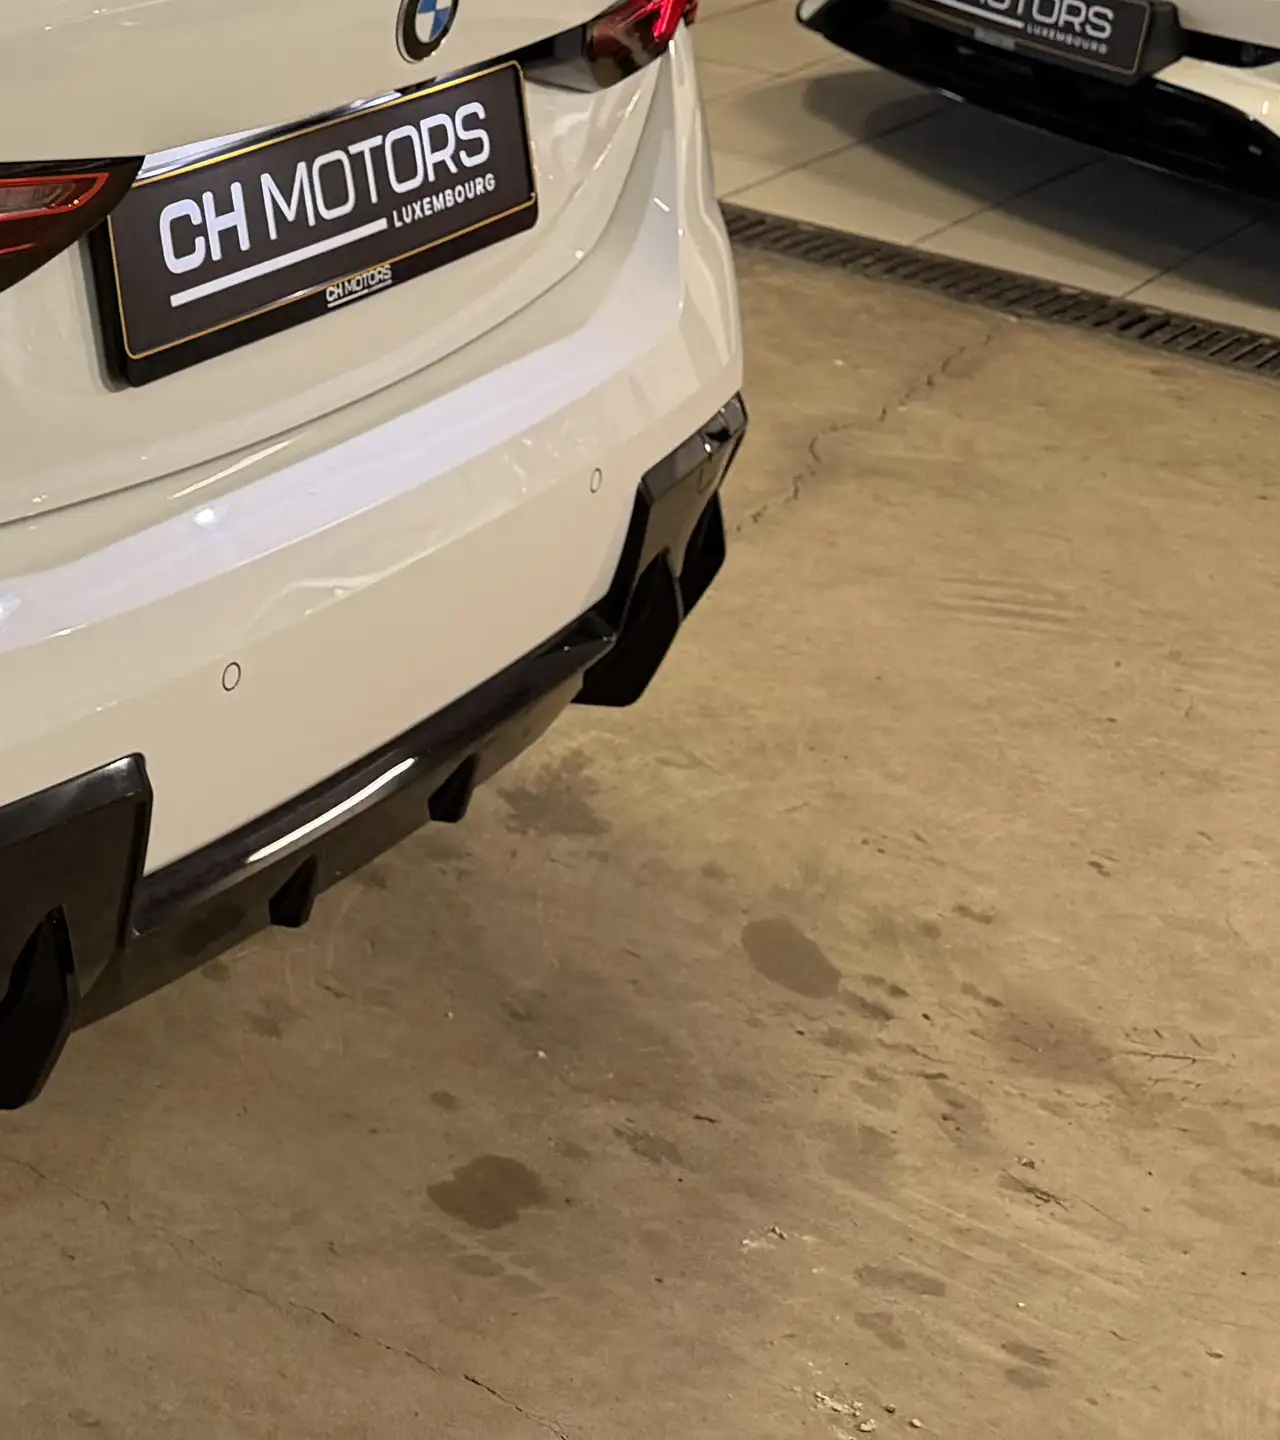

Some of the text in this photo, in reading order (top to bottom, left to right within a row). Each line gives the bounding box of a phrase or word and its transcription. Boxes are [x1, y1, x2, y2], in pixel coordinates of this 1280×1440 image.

[158, 101, 491, 275] CH MOTORS
[392, 172, 496, 228] LUXEMBOURG
[326, 282, 344, 302] CH
[344, 264, 392, 295] MOTORS
